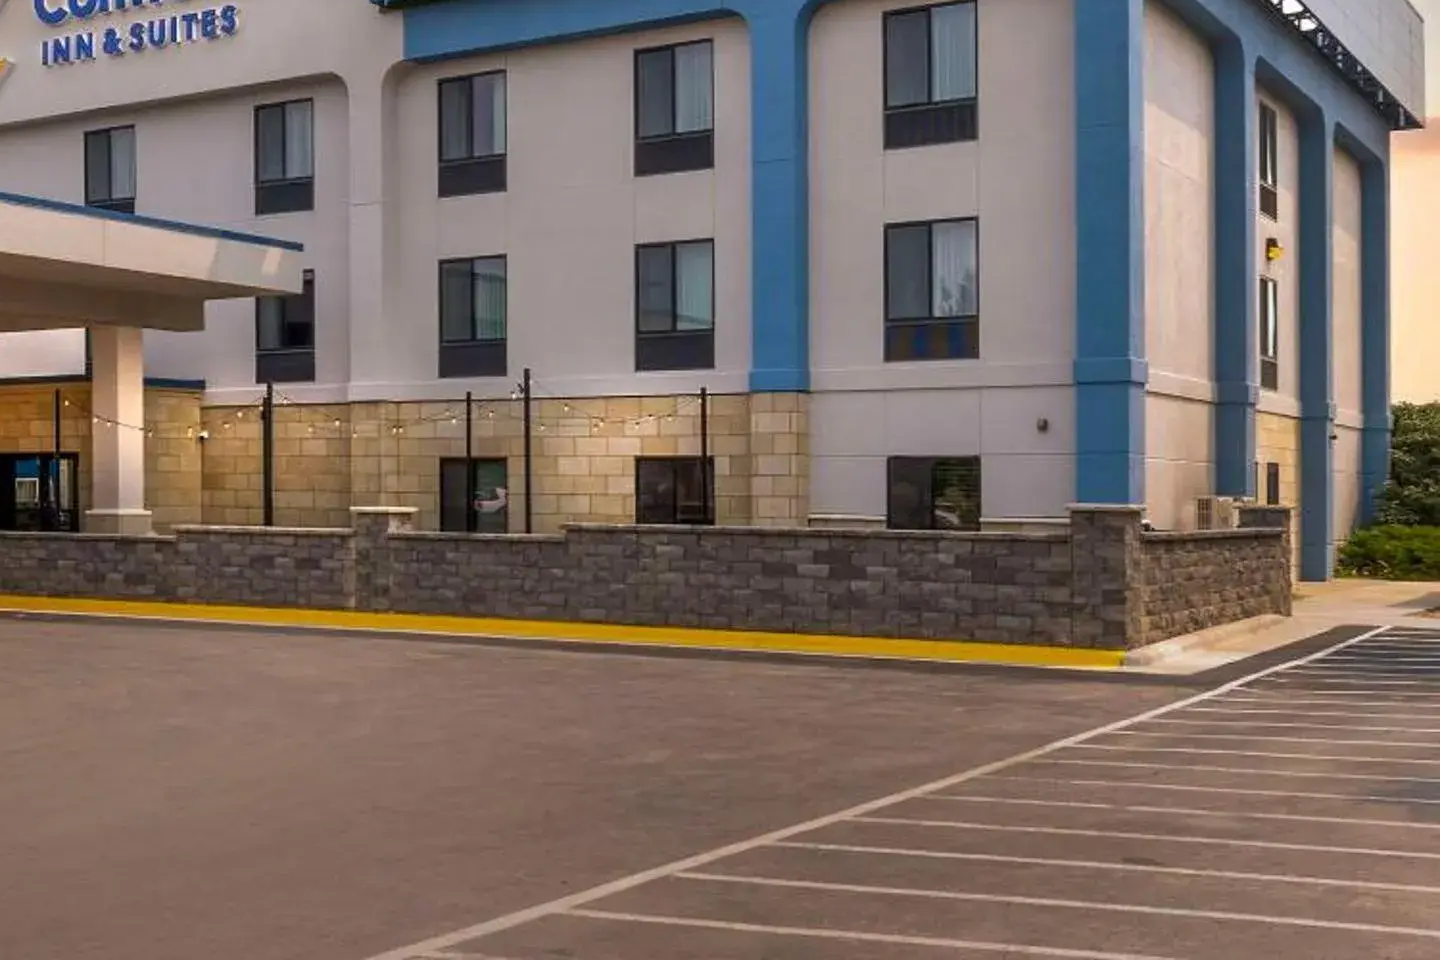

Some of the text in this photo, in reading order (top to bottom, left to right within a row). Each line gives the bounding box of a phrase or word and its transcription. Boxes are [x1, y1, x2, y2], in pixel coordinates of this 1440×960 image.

[42, 5, 238, 66] INN & SUITES
